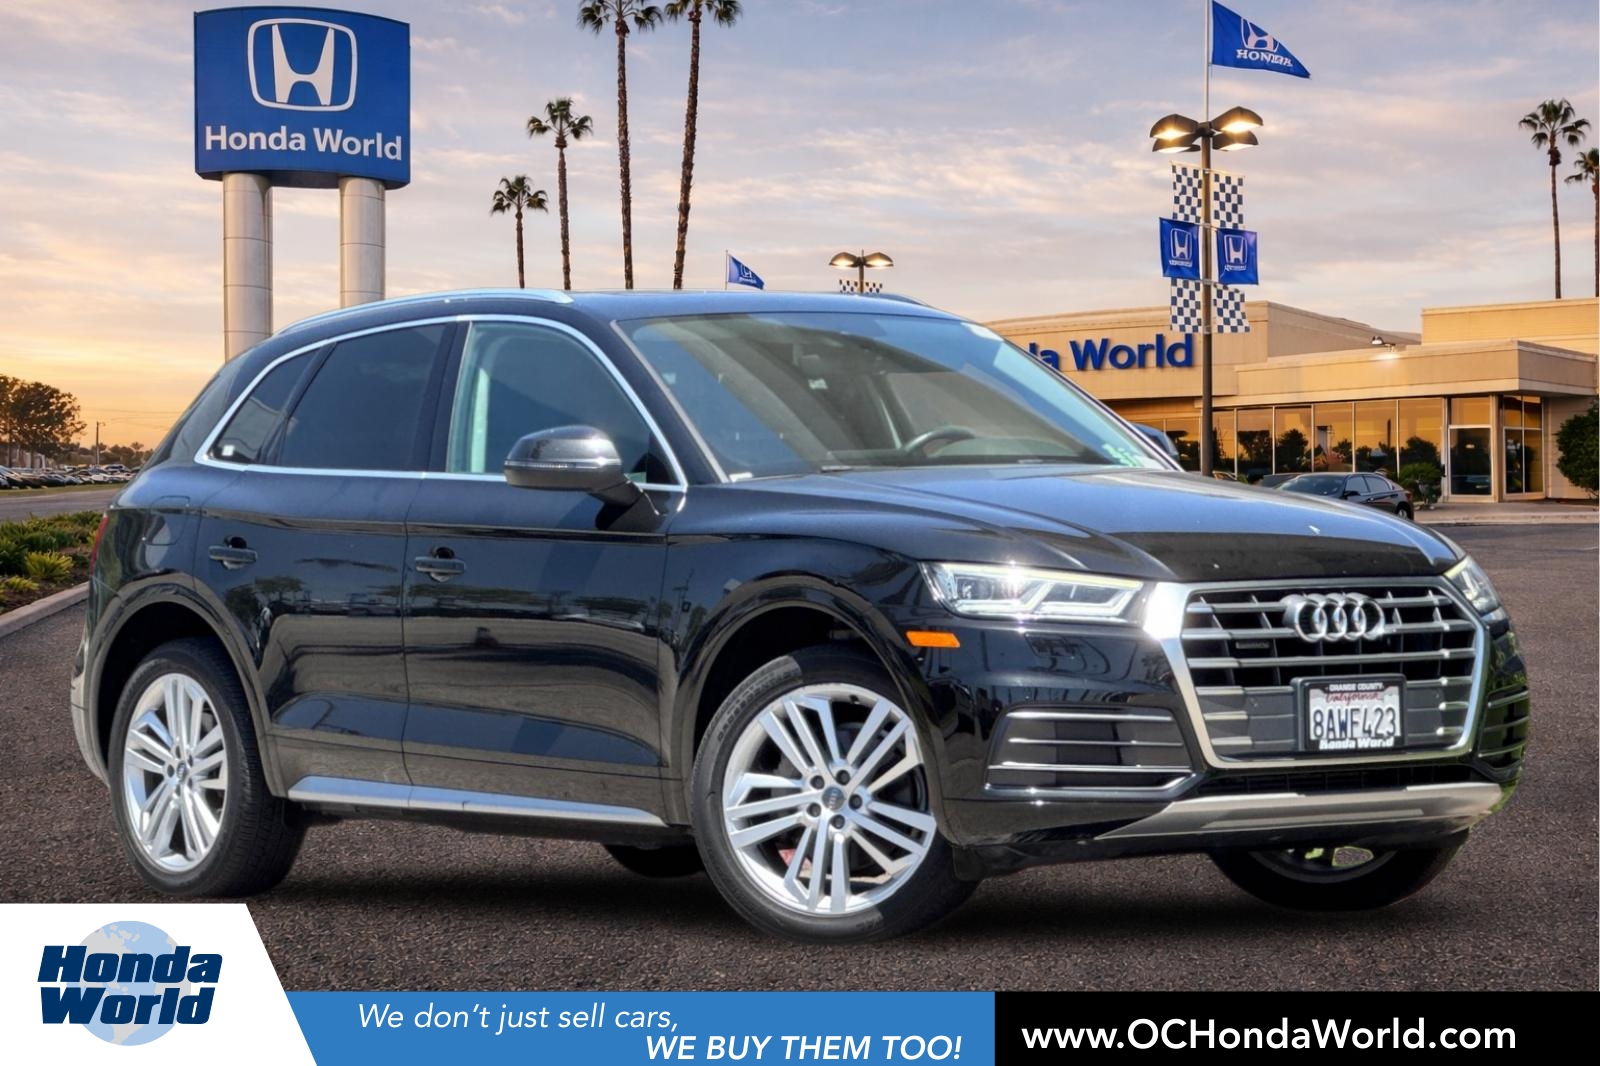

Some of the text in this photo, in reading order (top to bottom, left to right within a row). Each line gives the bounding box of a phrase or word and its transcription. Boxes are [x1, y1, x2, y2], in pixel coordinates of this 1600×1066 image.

[205, 125, 402, 161] Honda World
[1070, 333, 1194, 371] World
[1329, 683, 1356, 691] ORANGE
[1313, 707, 1396, 739] 8AWF423
[1319, 737, 1394, 750] Honda World
